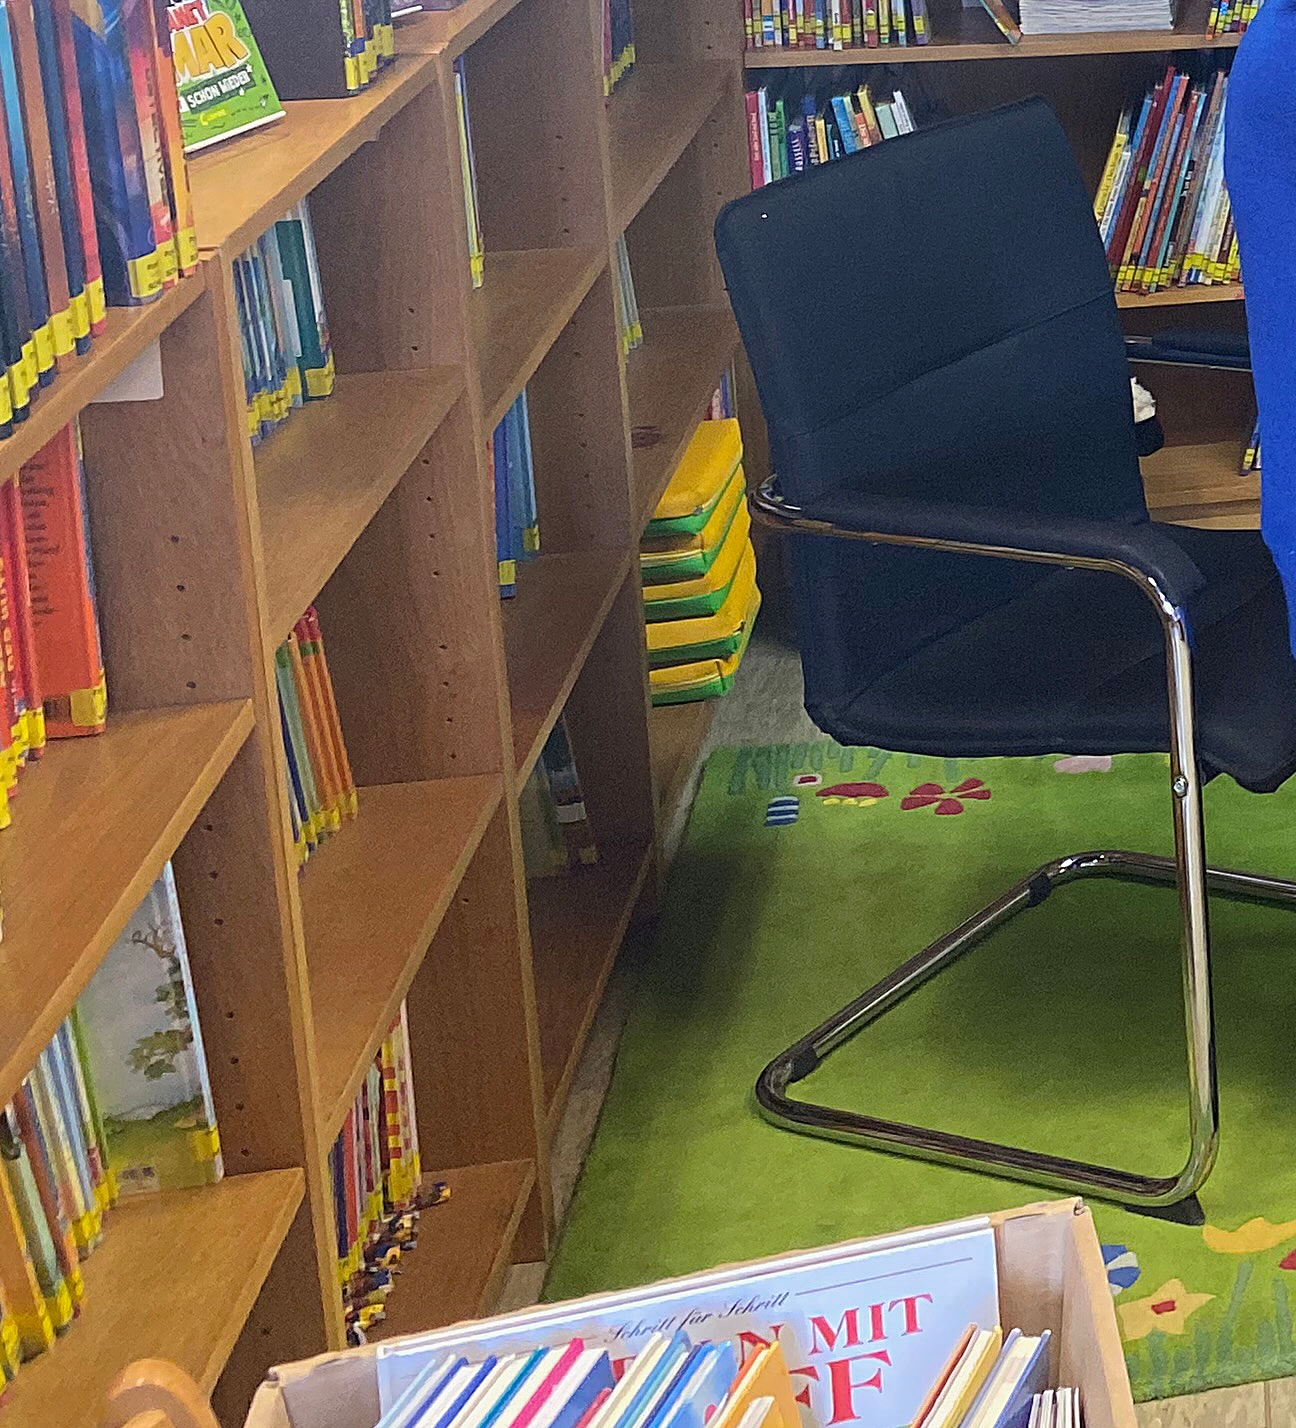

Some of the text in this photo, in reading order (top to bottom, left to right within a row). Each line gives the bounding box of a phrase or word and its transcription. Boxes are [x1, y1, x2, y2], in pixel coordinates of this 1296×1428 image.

[187, 70, 251, 109] SCHON WIEDER
[604, 1291, 790, 1343] Schritt für Schritt
[808, 1293, 934, 1356] MIT
